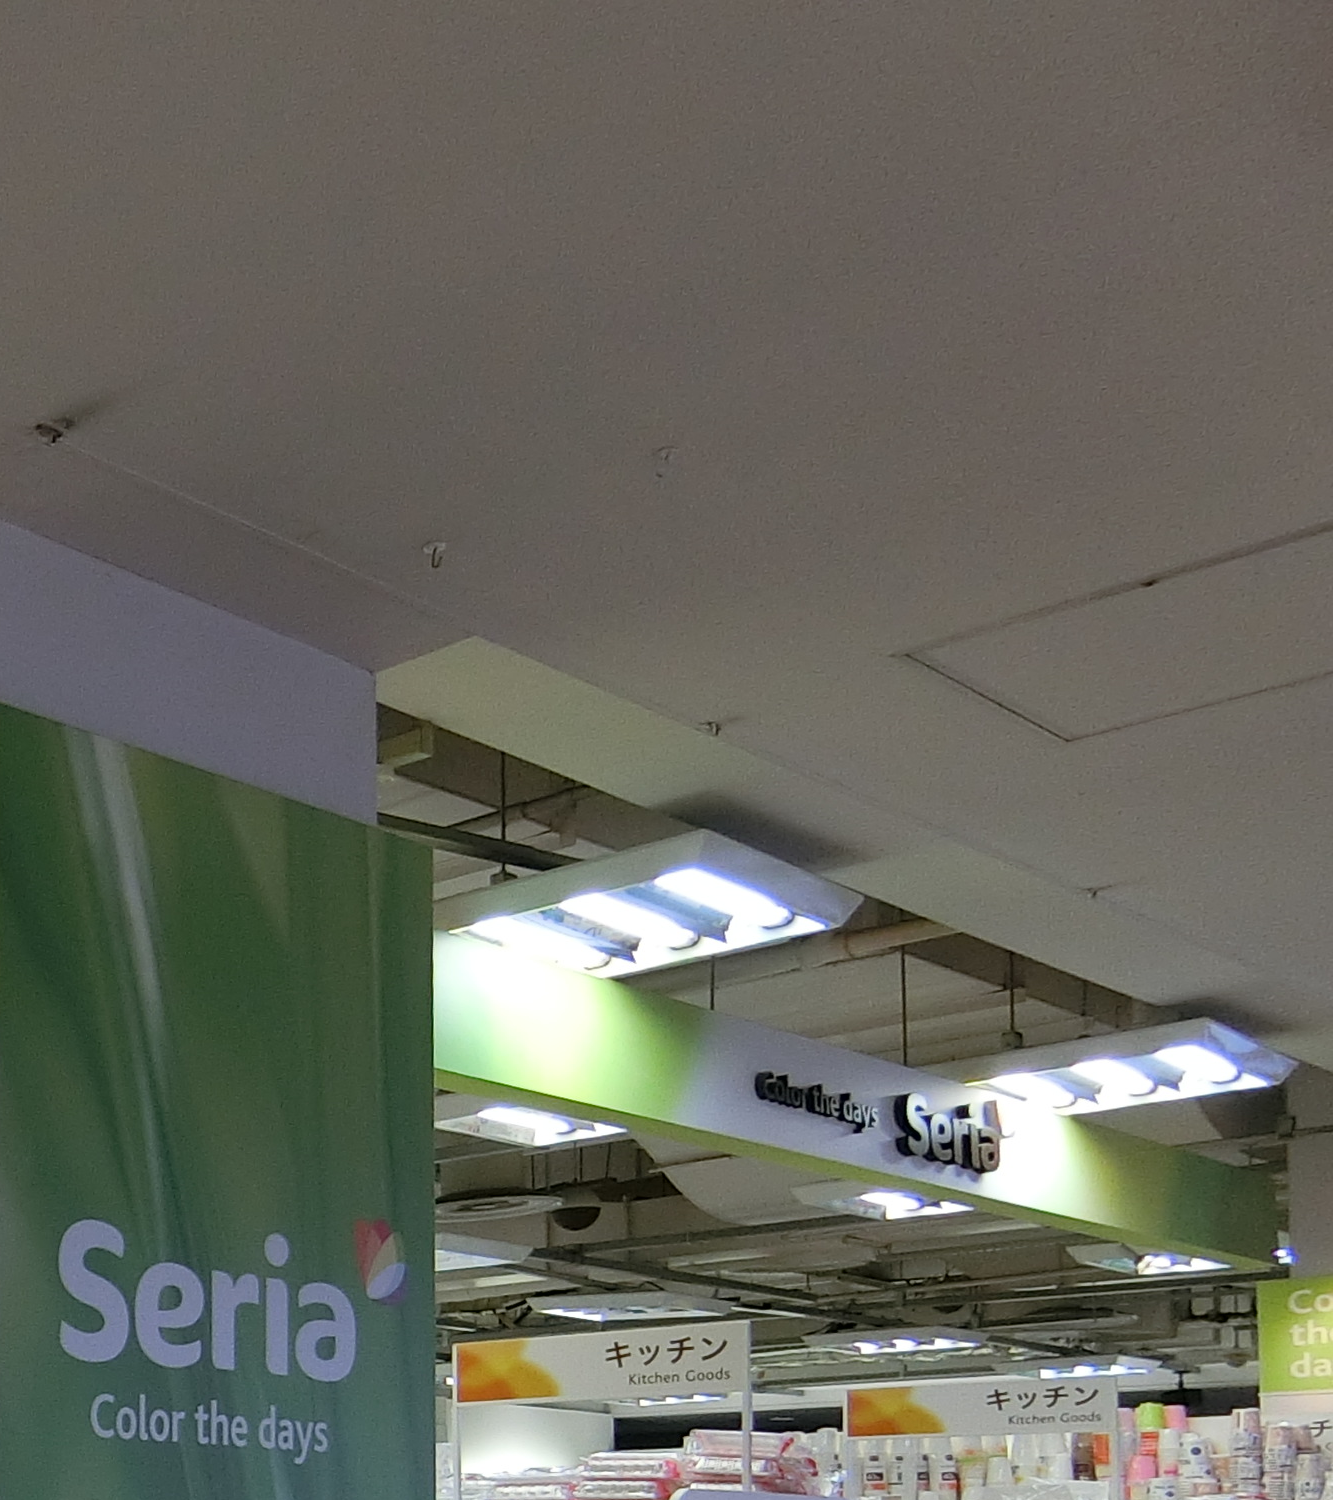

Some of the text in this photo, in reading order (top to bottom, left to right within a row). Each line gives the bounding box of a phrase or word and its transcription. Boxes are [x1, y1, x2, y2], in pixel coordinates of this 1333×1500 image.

[754, 1071, 810, 1110] Color
[841, 1092, 880, 1134] days
[894, 1092, 1001, 1175] Seria
[58, 1218, 357, 1382] Seria
[605, 1336, 728, 1368] キッチン
[628, 1368, 731, 1385] Kitchen Goods
[986, 1385, 1100, 1411] キッチン
[90, 1393, 329, 1465] Color the days
[1008, 1412, 1102, 1425] Kitchen Goods
